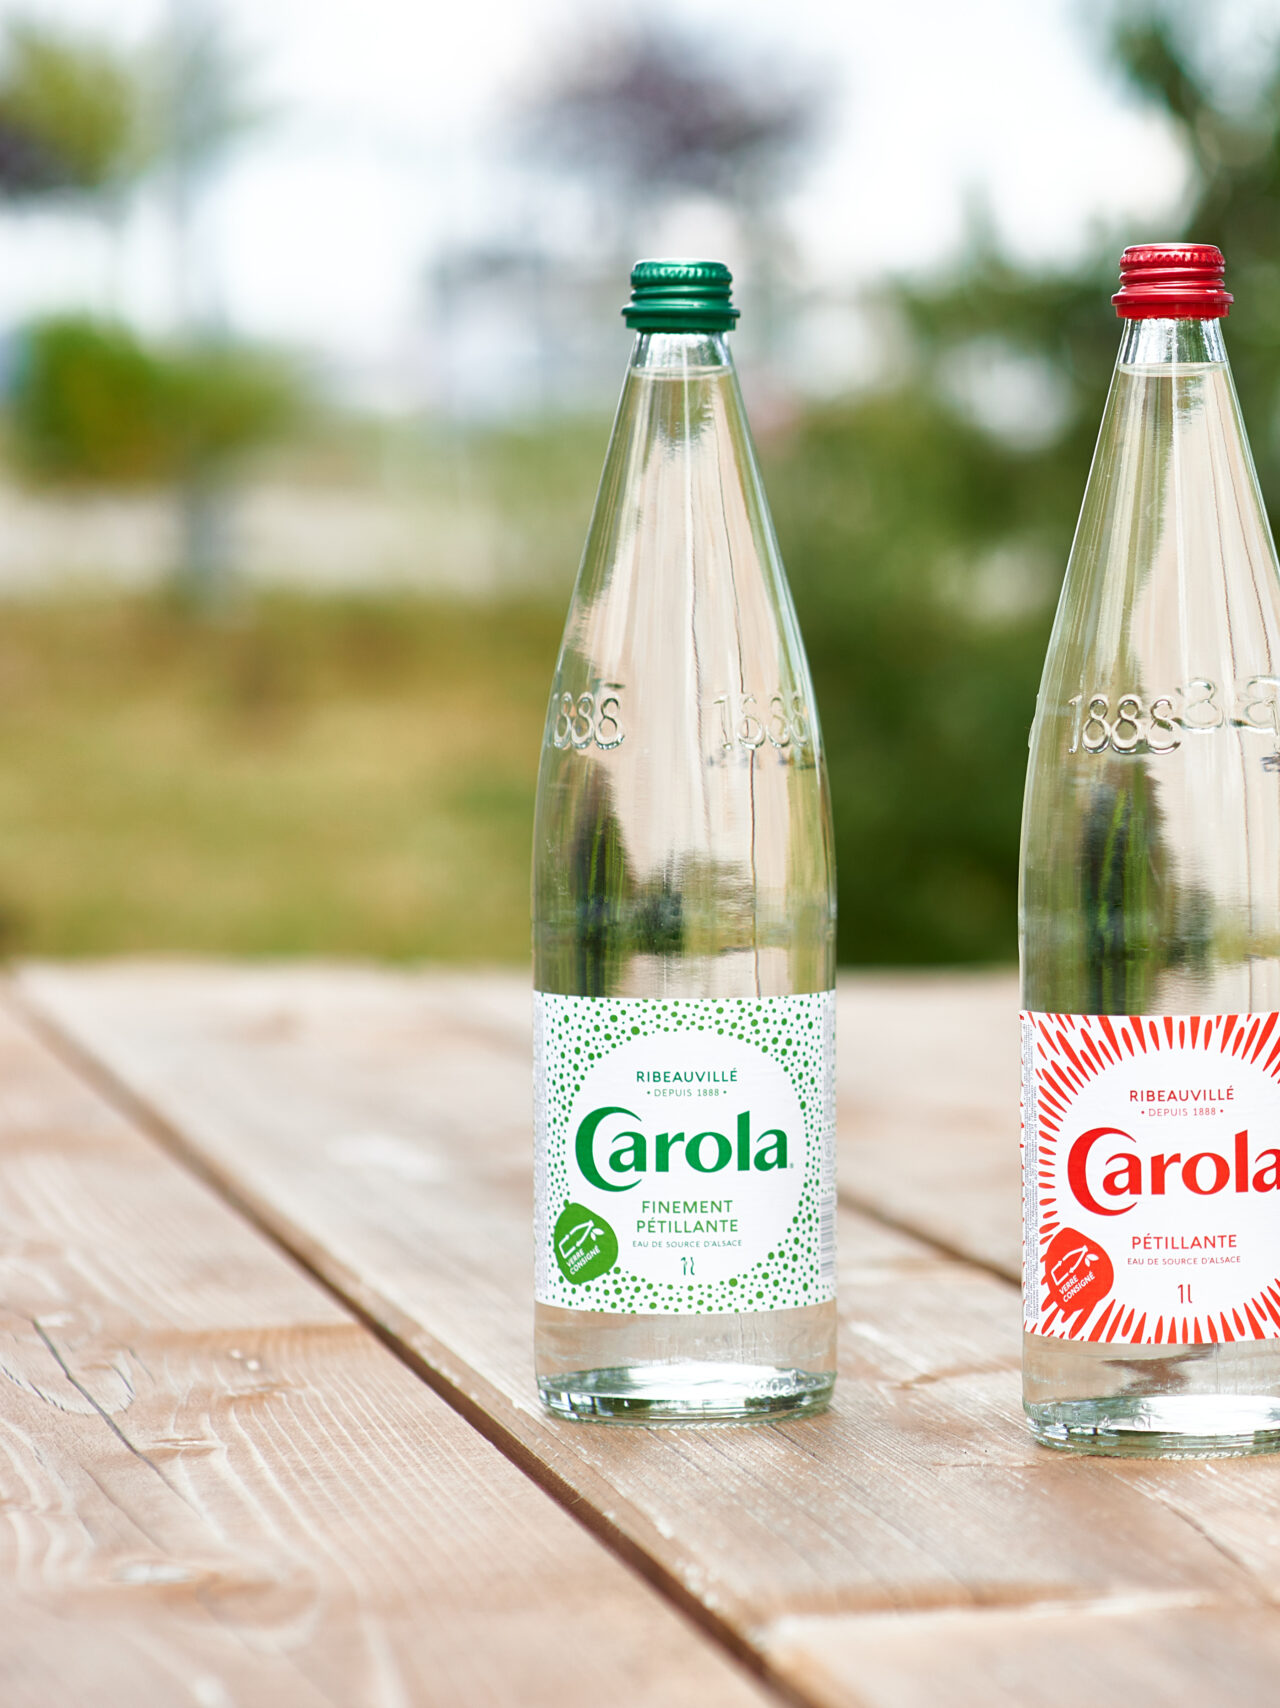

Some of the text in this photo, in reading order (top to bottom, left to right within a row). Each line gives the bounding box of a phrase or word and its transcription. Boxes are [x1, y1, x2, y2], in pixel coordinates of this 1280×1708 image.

[1067, 694, 1181, 753] 1888
[636, 1067, 738, 1083] RIBEAUVILLÉ
[654, 1088, 720, 1097] DEPUIS 1888
[1129, 1085, 1235, 1103] RIBEAUVILLÉ
[1148, 1106, 1216, 1117] DEPUIS 1888
[575, 1106, 788, 1193] Carola
[641, 1200, 734, 1214] FINEMENT
[636, 1217, 739, 1234] PÉTILLANTE
[632, 1240, 650, 1248] EAU
[1130, 1233, 1238, 1251] PÉTILLANTE
[566, 1248, 585, 1268] VERRE
[1127, 1255, 1241, 1266] EAU DE SOURCE D'ALSACE
[1058, 1274, 1079, 1295] VERRE
